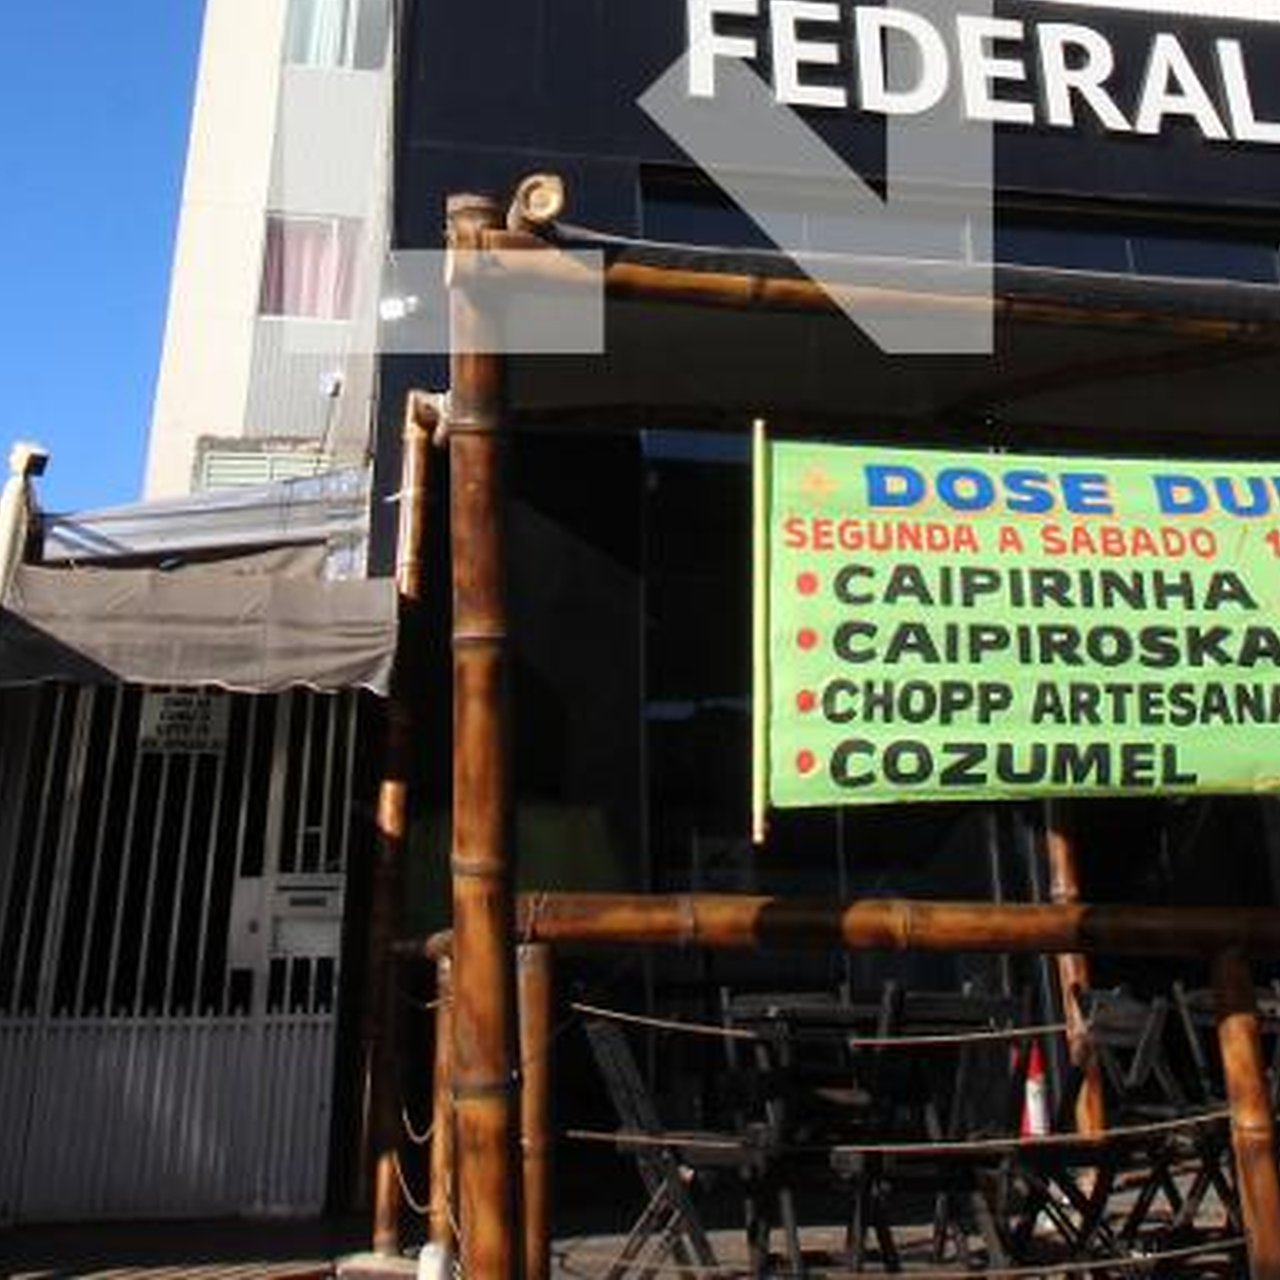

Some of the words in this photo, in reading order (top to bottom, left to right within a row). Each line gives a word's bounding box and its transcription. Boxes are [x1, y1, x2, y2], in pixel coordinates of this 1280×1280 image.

[863, 464, 1116, 515] DOSE
[783, 517, 979, 554] SEGUNDA
[998, 524, 1025, 554] A
[832, 563, 1259, 611] CAIPIRINHA
[822, 678, 1015, 725] CHOPP
[828, 738, 1199, 788] COZUMEL
